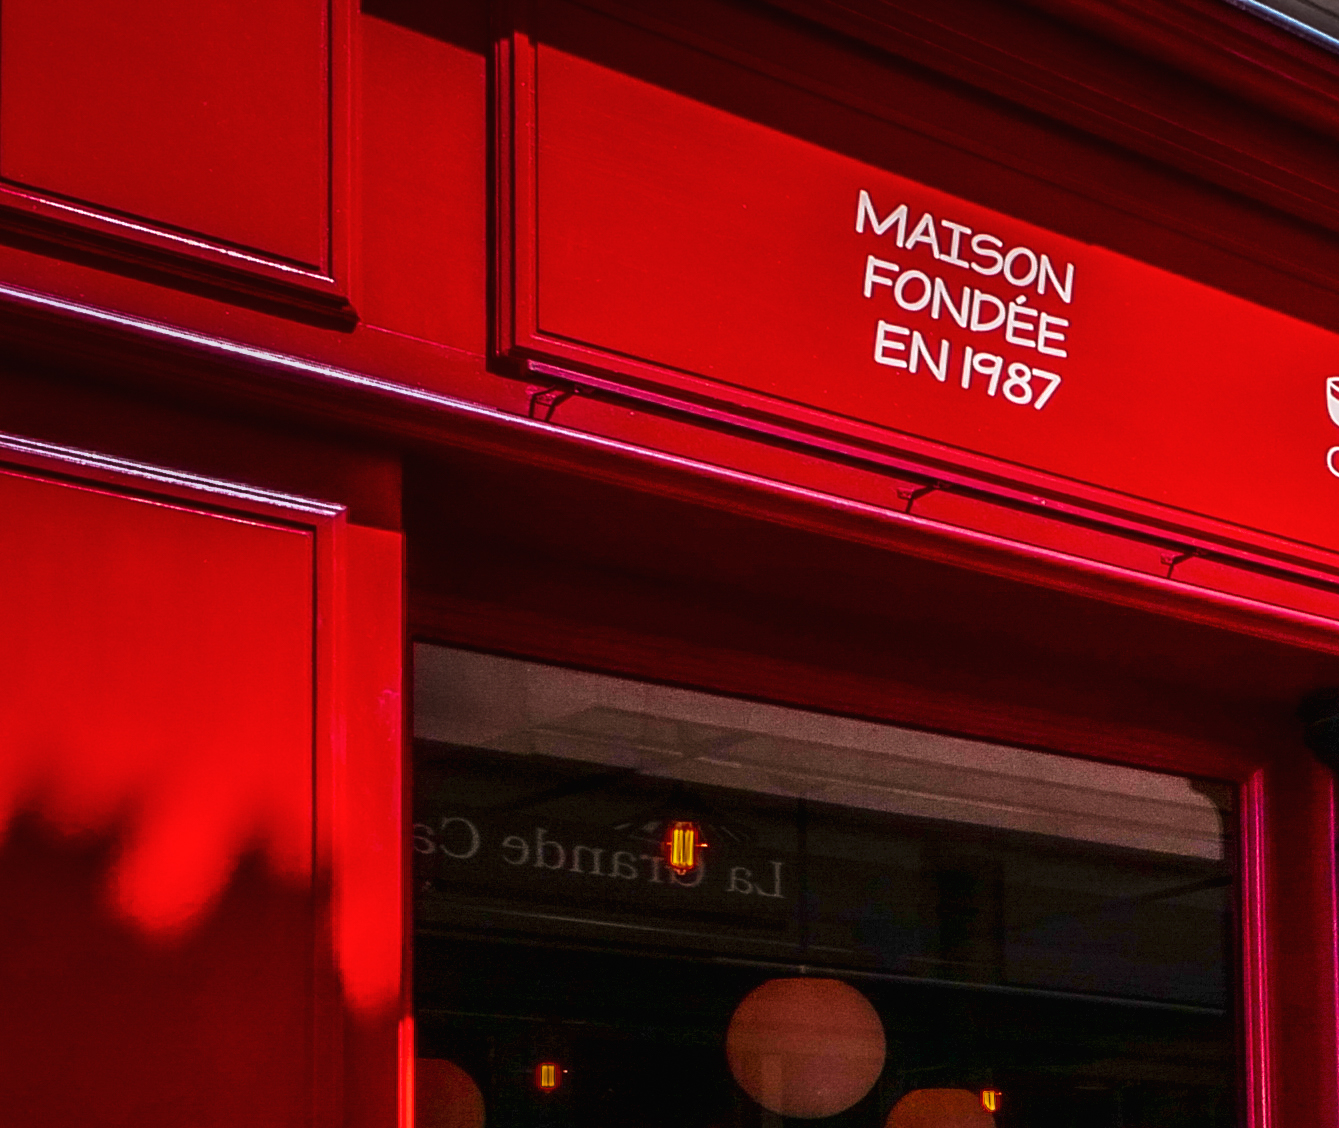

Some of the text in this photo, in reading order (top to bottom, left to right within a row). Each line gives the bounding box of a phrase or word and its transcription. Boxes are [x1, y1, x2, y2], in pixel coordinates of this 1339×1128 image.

[855, 190, 1074, 303] MAISON
[864, 255, 1069, 358] FONDÉE
[875, 320, 1061, 410] EN 1987
